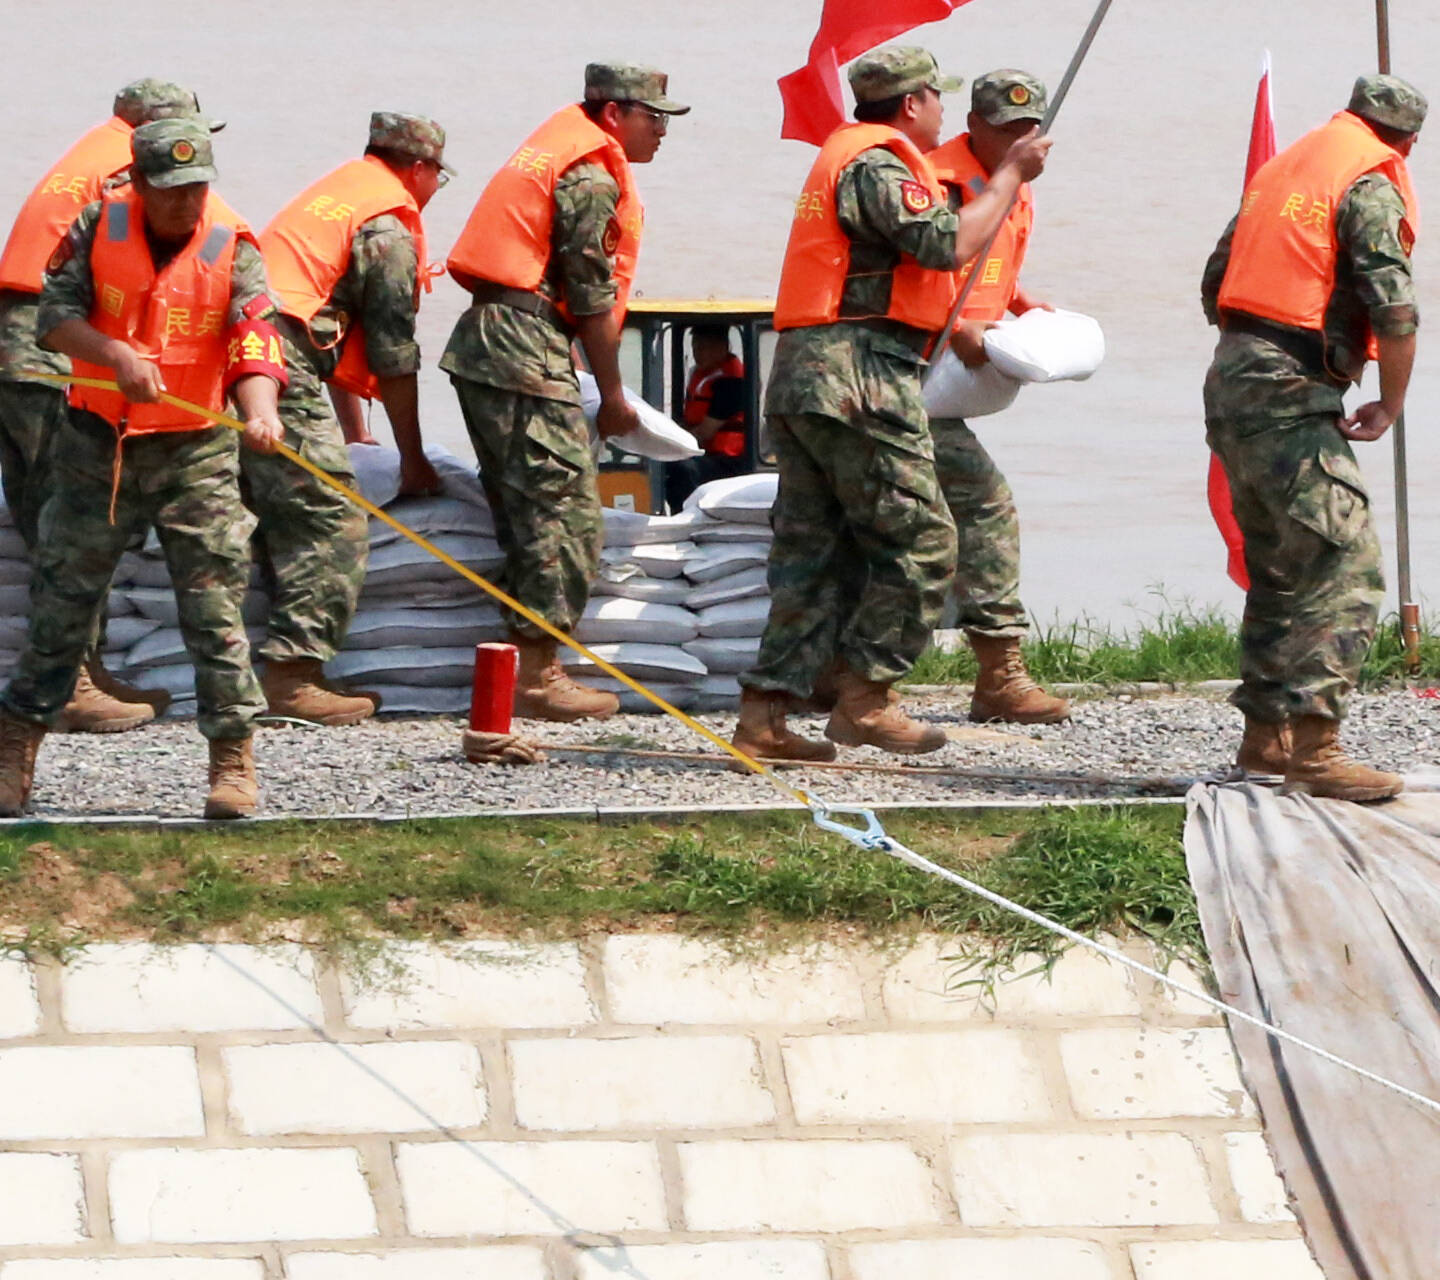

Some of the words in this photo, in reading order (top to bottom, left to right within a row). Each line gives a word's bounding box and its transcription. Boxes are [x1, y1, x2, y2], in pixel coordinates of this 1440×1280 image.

[511, 147, 553, 176] 民兵
[42, 173, 88, 203] 民兵
[304, 195, 356, 221] 民兵
[1279, 192, 1329, 234] 民兵
[167, 307, 223, 336] 民兵
